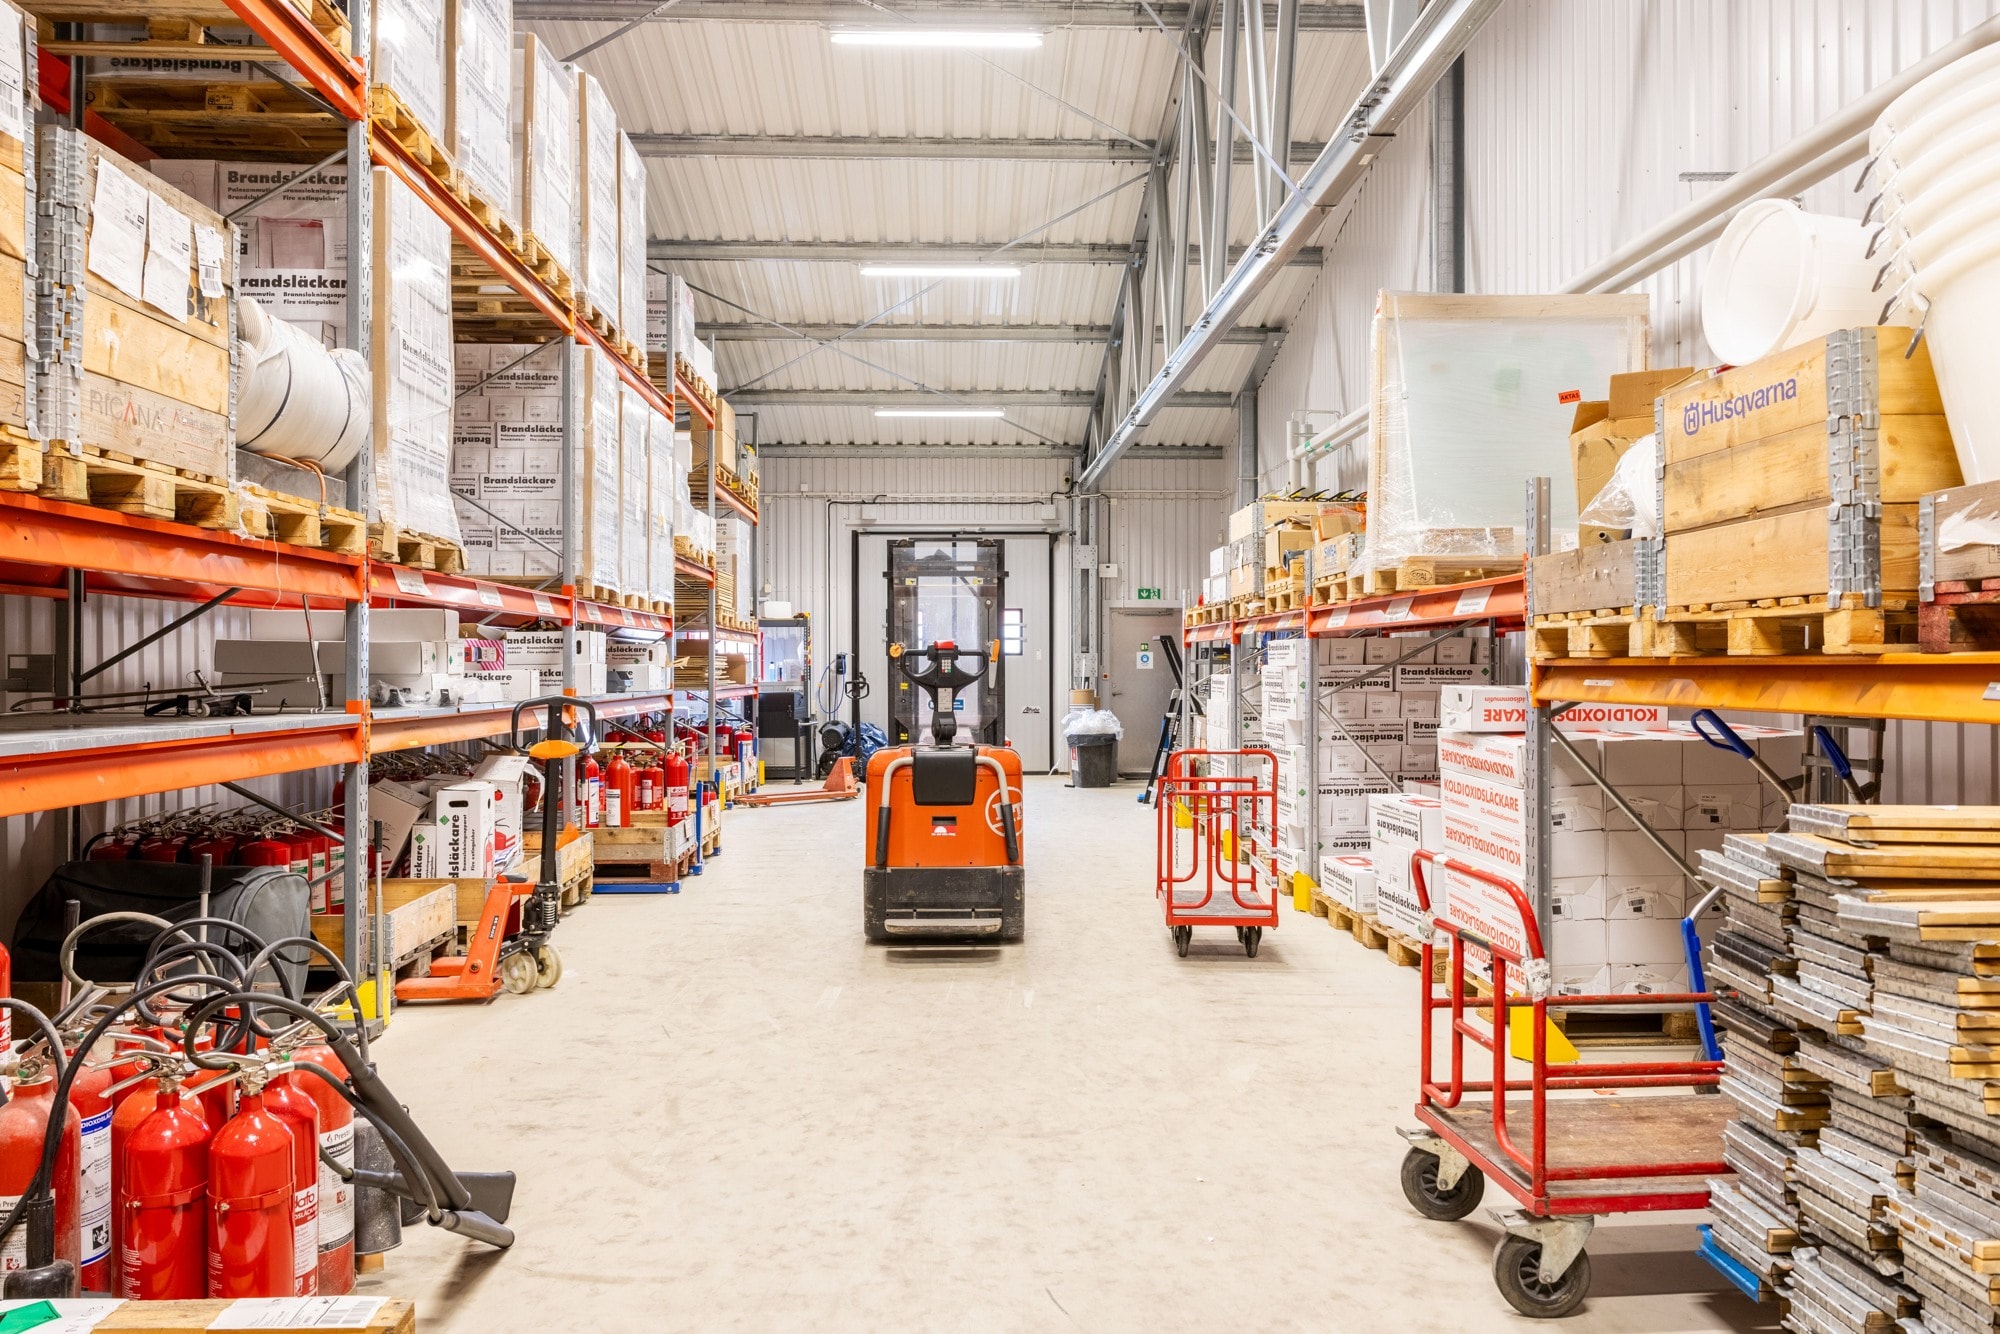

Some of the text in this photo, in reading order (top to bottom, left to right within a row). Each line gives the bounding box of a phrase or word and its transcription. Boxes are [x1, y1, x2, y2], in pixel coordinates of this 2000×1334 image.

[240, 275, 347, 289] randsläckar
[486, 372, 559, 381] Bandsläckare
[1702, 378, 1797, 427] Husqvarna
[500, 425, 563, 433] Brandsläcka
[454, 436, 491, 445] Brandsl
[484, 476, 556, 485] Brandsläckare
[1400, 667, 1473, 676] Brandsläckare
[1444, 778, 1519, 812] KOLDIOXIDSLÄCKARE
[1377, 819, 1419, 842] Brandsläckare
[449, 814, 460, 878] dsläckare
[1333, 841, 1371, 850] läckare
[1446, 826, 1521, 866] KOLDIOXIDSLÄCKARE
[1378, 886, 1421, 915] Brandsläckare
